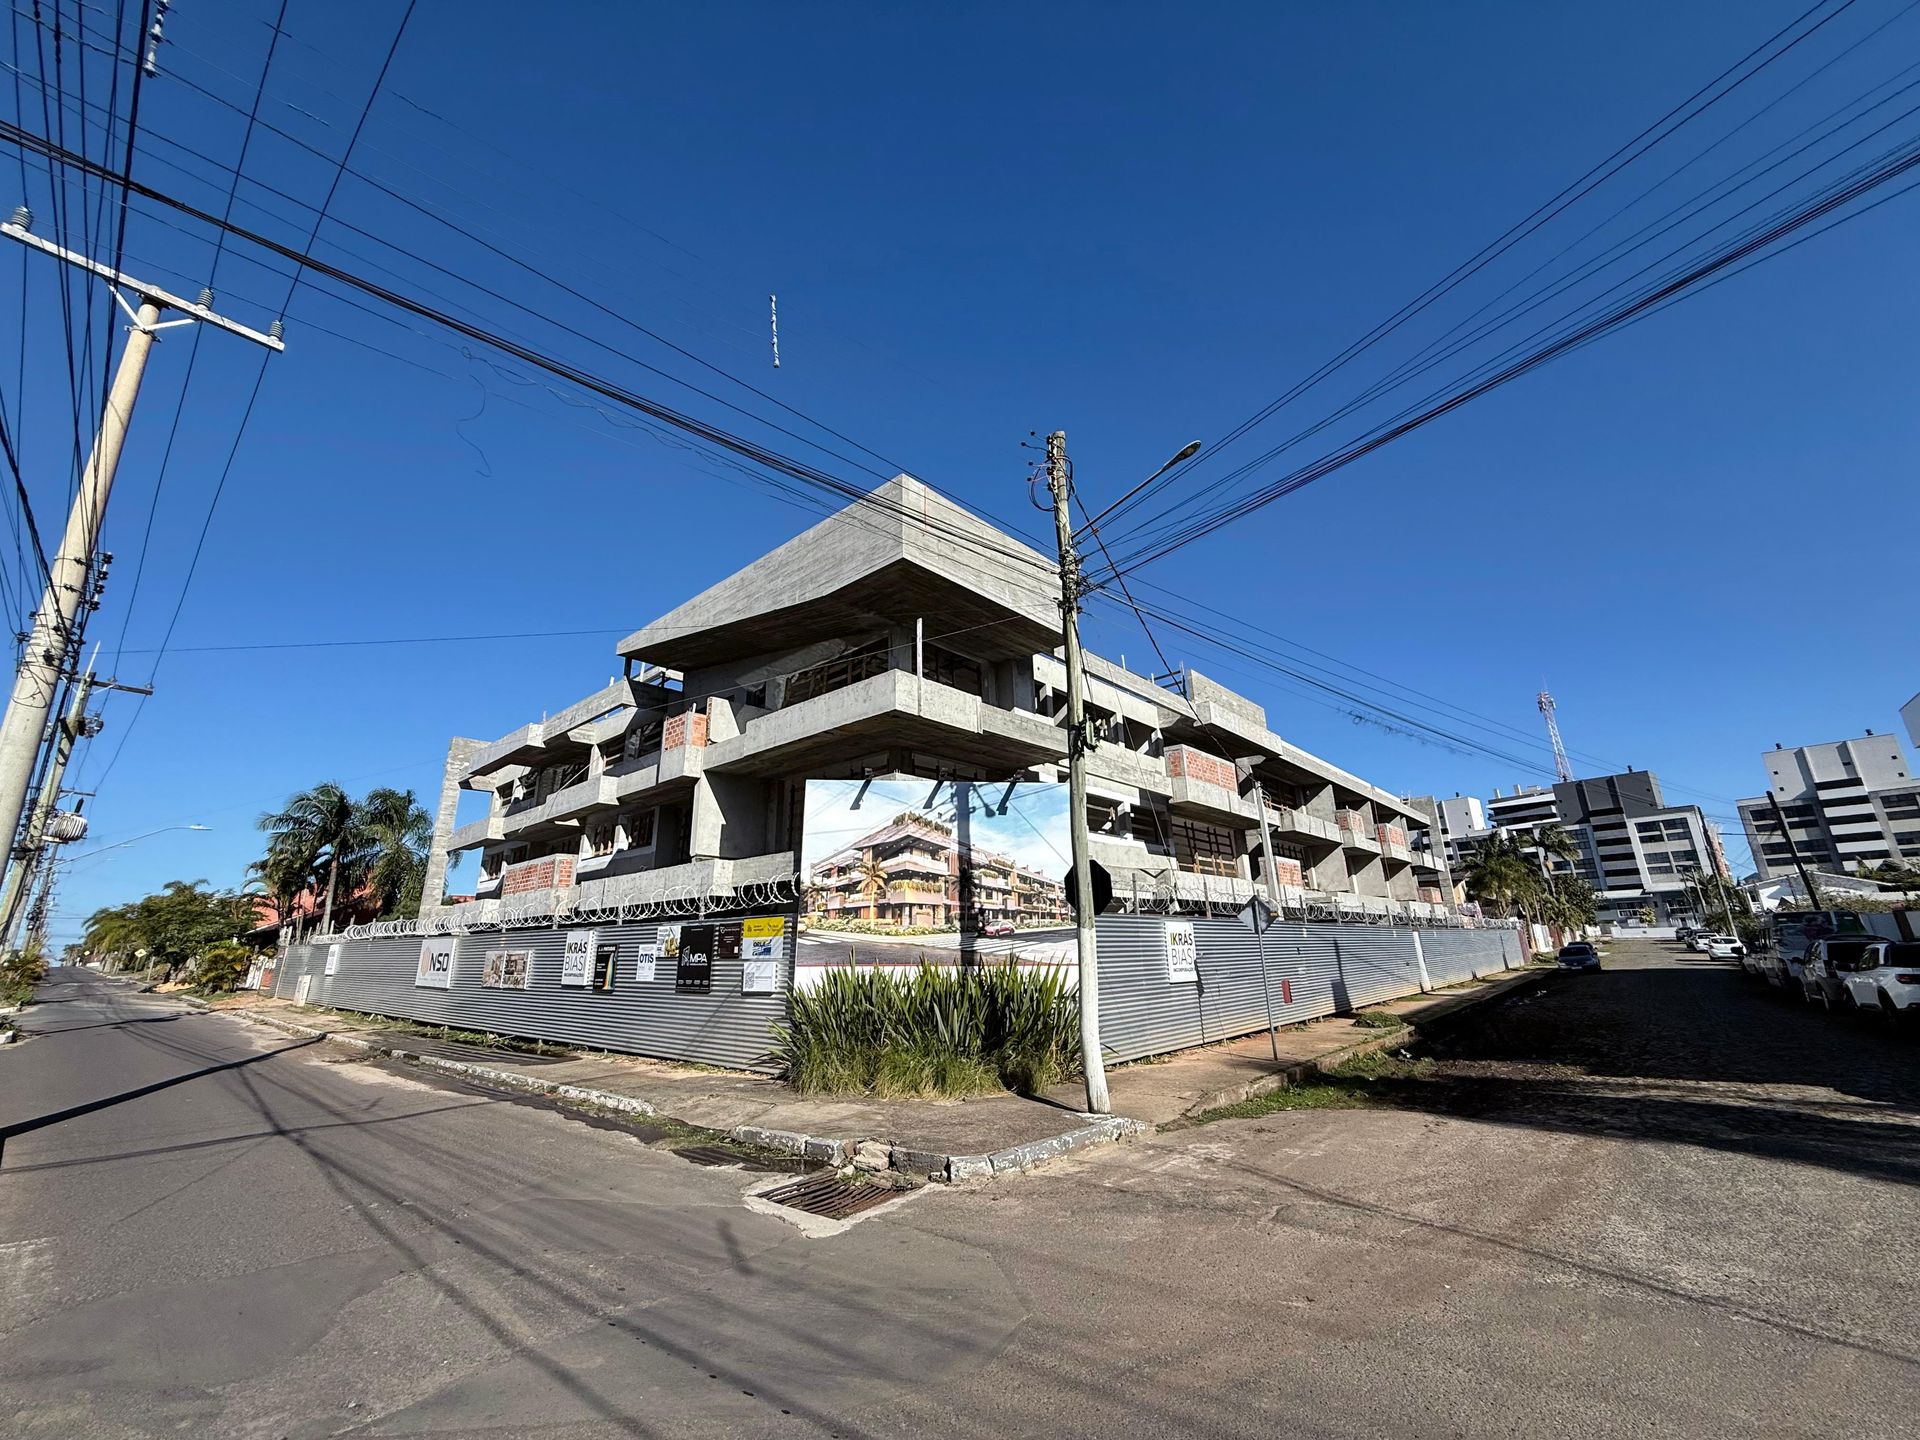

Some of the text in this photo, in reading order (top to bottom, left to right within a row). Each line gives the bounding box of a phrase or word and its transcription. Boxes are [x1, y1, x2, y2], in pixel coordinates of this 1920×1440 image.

[429, 952, 450, 972] NSO
[639, 953, 655, 964] OTIS
[689, 953, 708, 963] MPA
